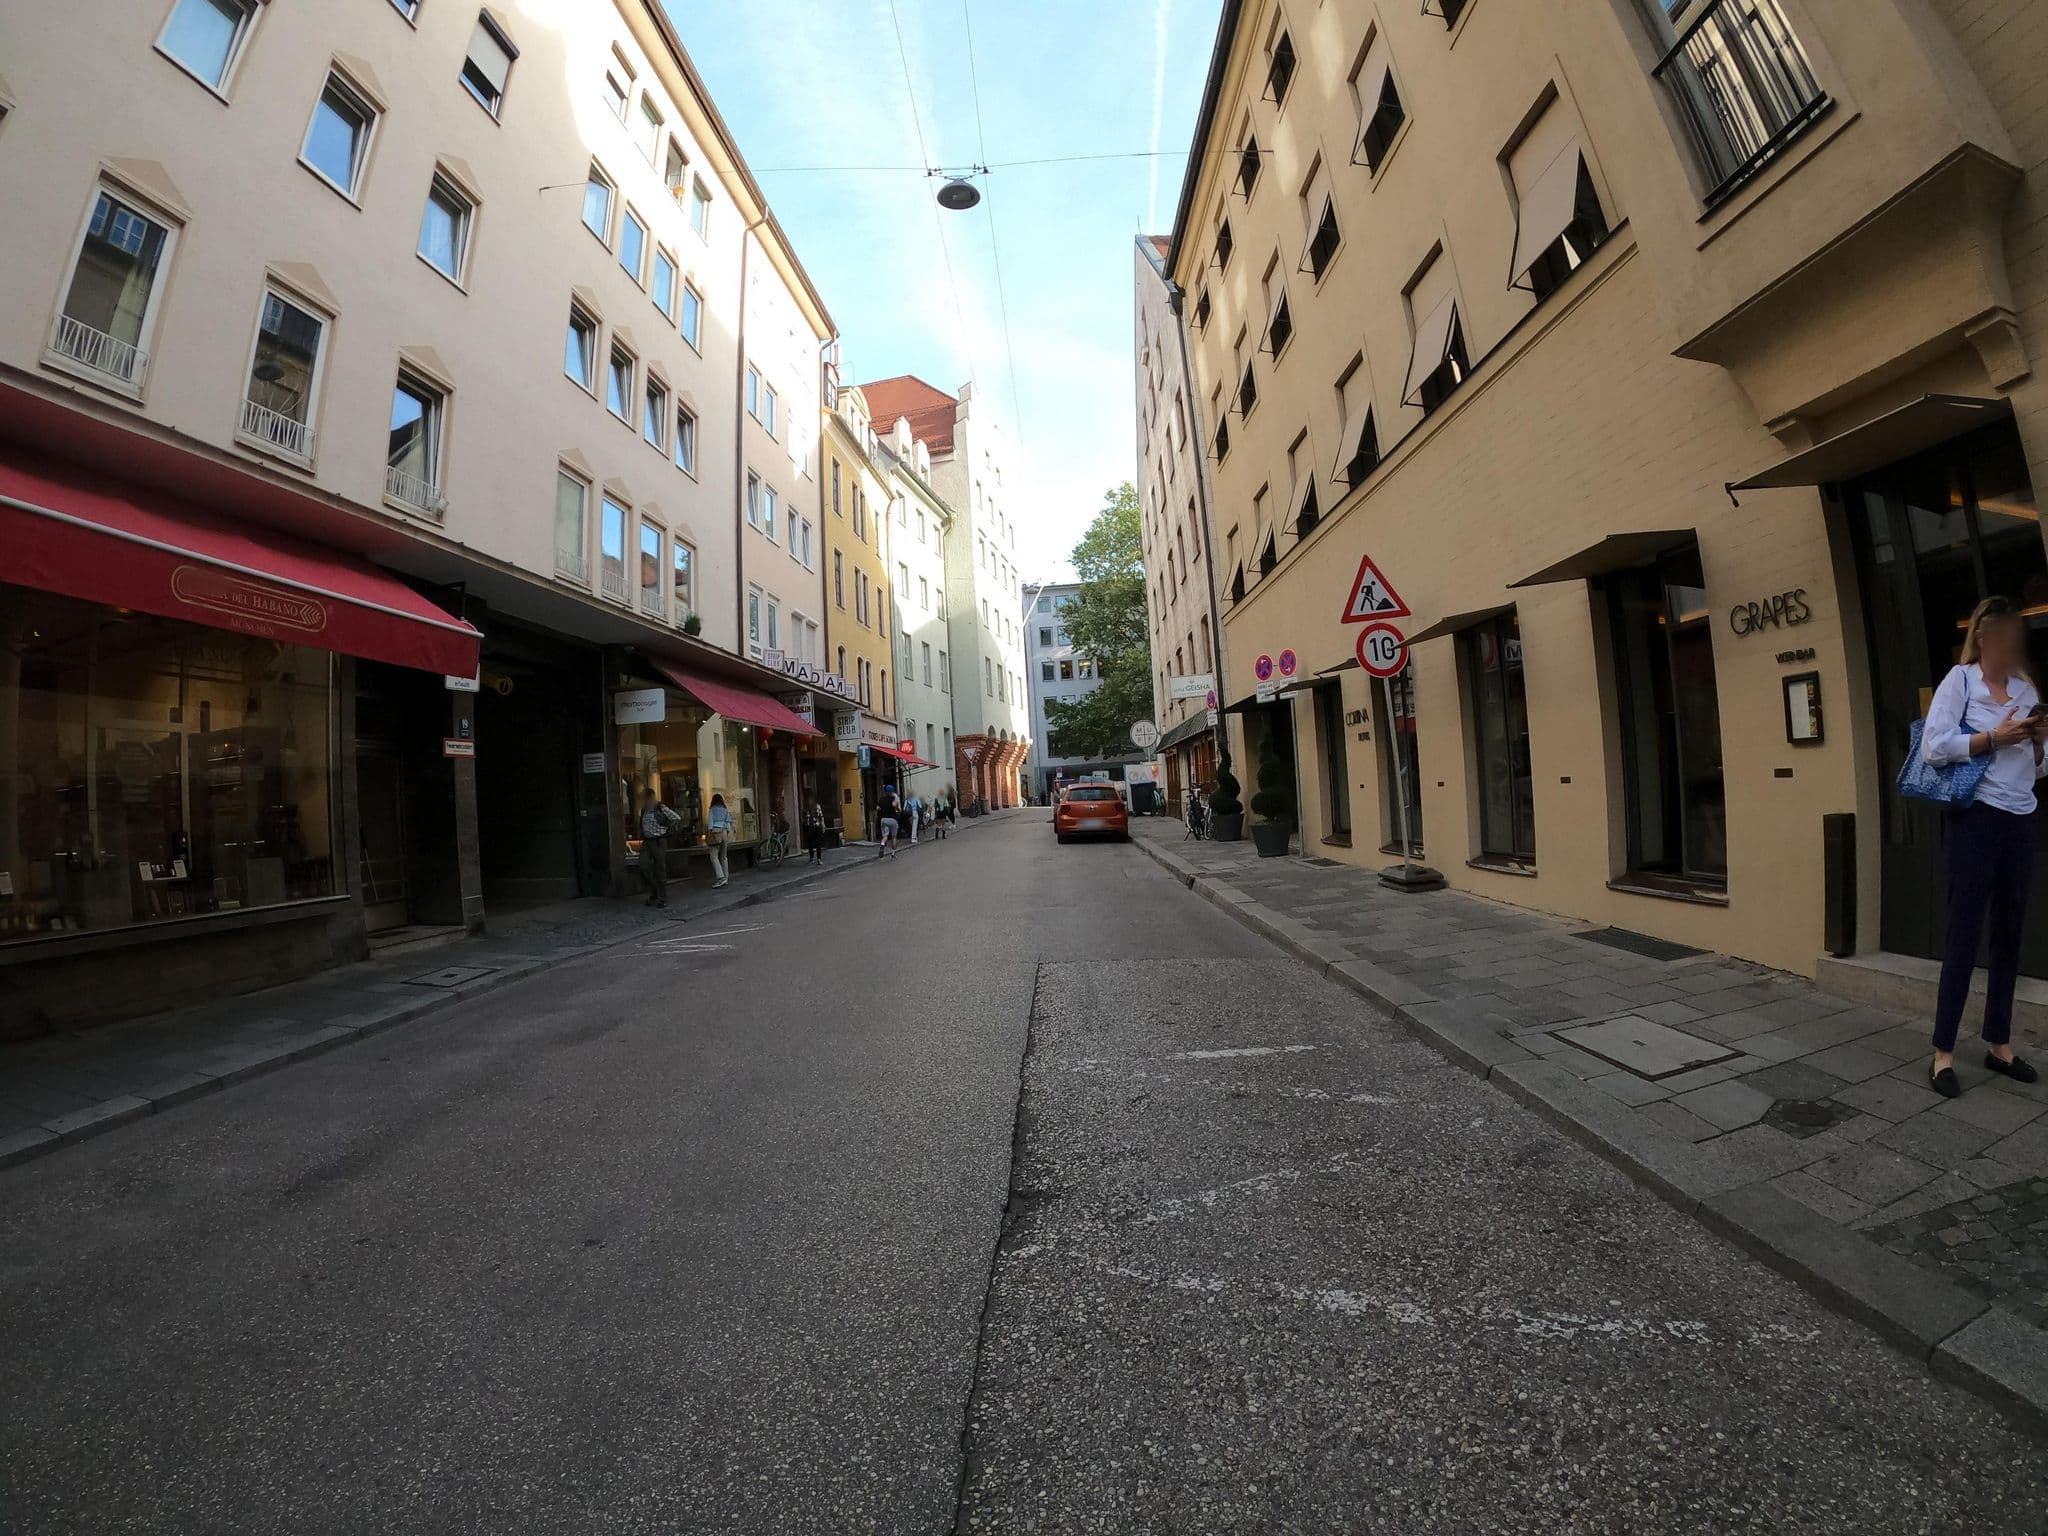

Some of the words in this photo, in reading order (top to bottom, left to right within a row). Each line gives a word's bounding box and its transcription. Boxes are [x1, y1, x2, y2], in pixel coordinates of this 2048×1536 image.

[232, 595, 250, 605] DEL
[254, 596, 299, 616] HABANO
[1730, 588, 1809, 635] GRAPES
[1369, 636, 1396, 662] 10
[784, 660, 844, 692] MADAM
[1185, 684, 1211, 692] GEISHA
[837, 713, 856, 726] STRIP
[838, 725, 857, 736] CLUB
